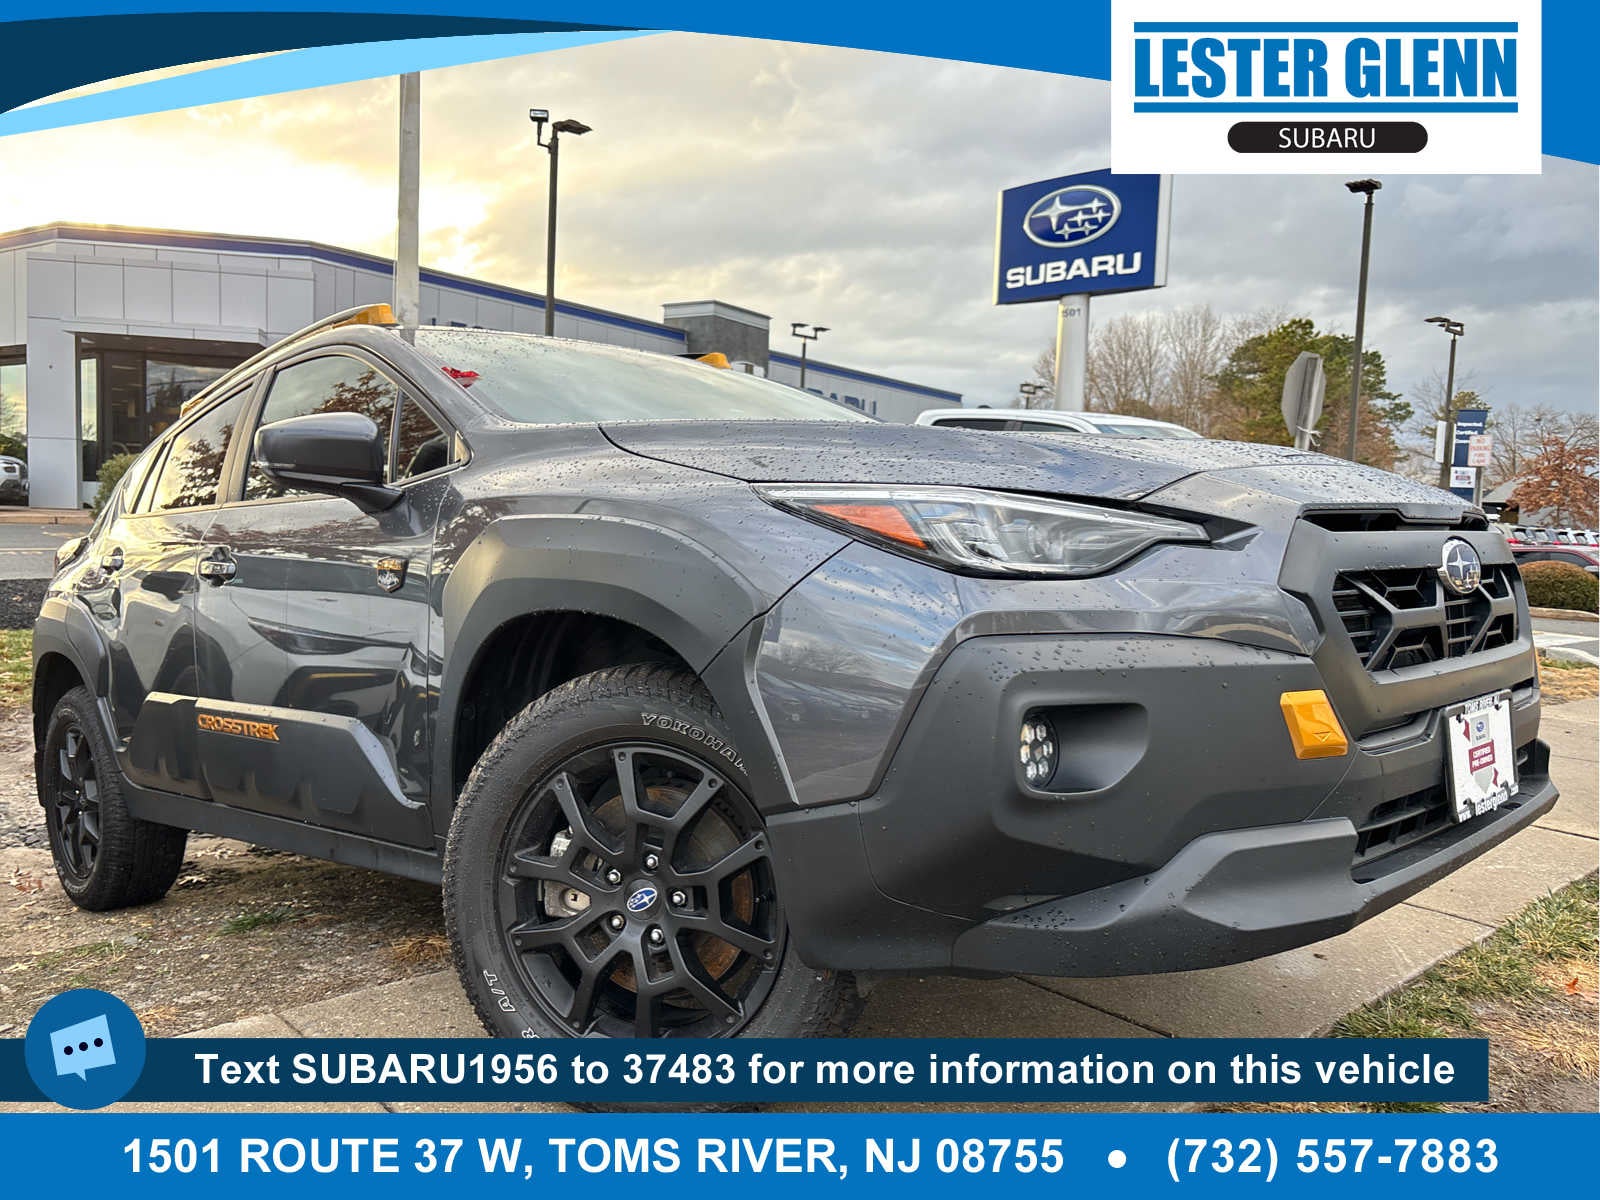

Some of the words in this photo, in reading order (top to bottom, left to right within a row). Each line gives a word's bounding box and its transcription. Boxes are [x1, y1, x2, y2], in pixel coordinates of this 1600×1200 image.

[1006, 252, 1141, 288] SUBARU
[198, 714, 280, 741] CROSSTREK
[483, 969, 515, 1011] A/T
